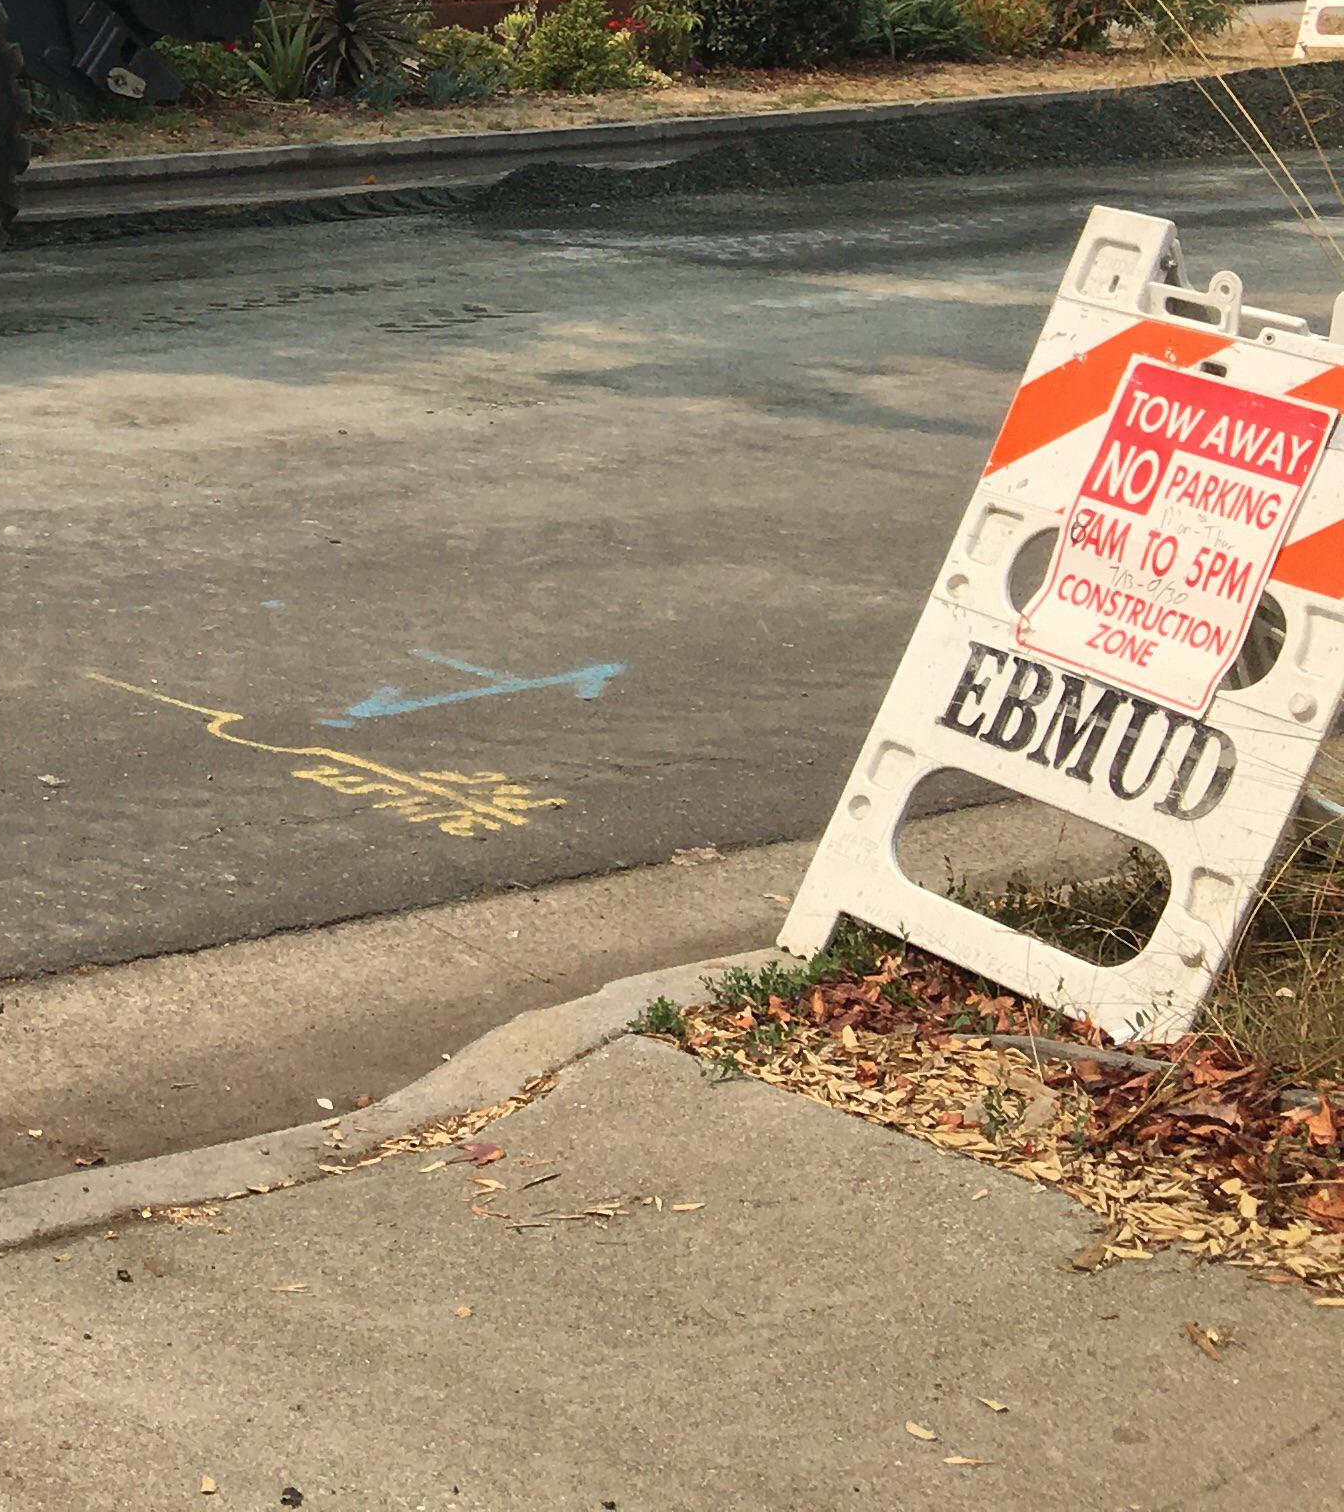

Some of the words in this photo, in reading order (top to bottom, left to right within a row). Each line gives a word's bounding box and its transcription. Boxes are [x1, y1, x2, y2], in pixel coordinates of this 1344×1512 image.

[1126, 390, 1206, 443] TOW
[1200, 415, 1313, 475] AWAY
[1091, 440, 1160, 505] NO
[1164, 464, 1282, 530] PARKING
[1140, 530, 1179, 577] TO
[1185, 547, 1253, 604] 5PM
[1057, 574, 1232, 656] CONSTRUCTION
[1086, 623, 1159, 668] ZONE
[934, 640, 1238, 821] EBMUD
